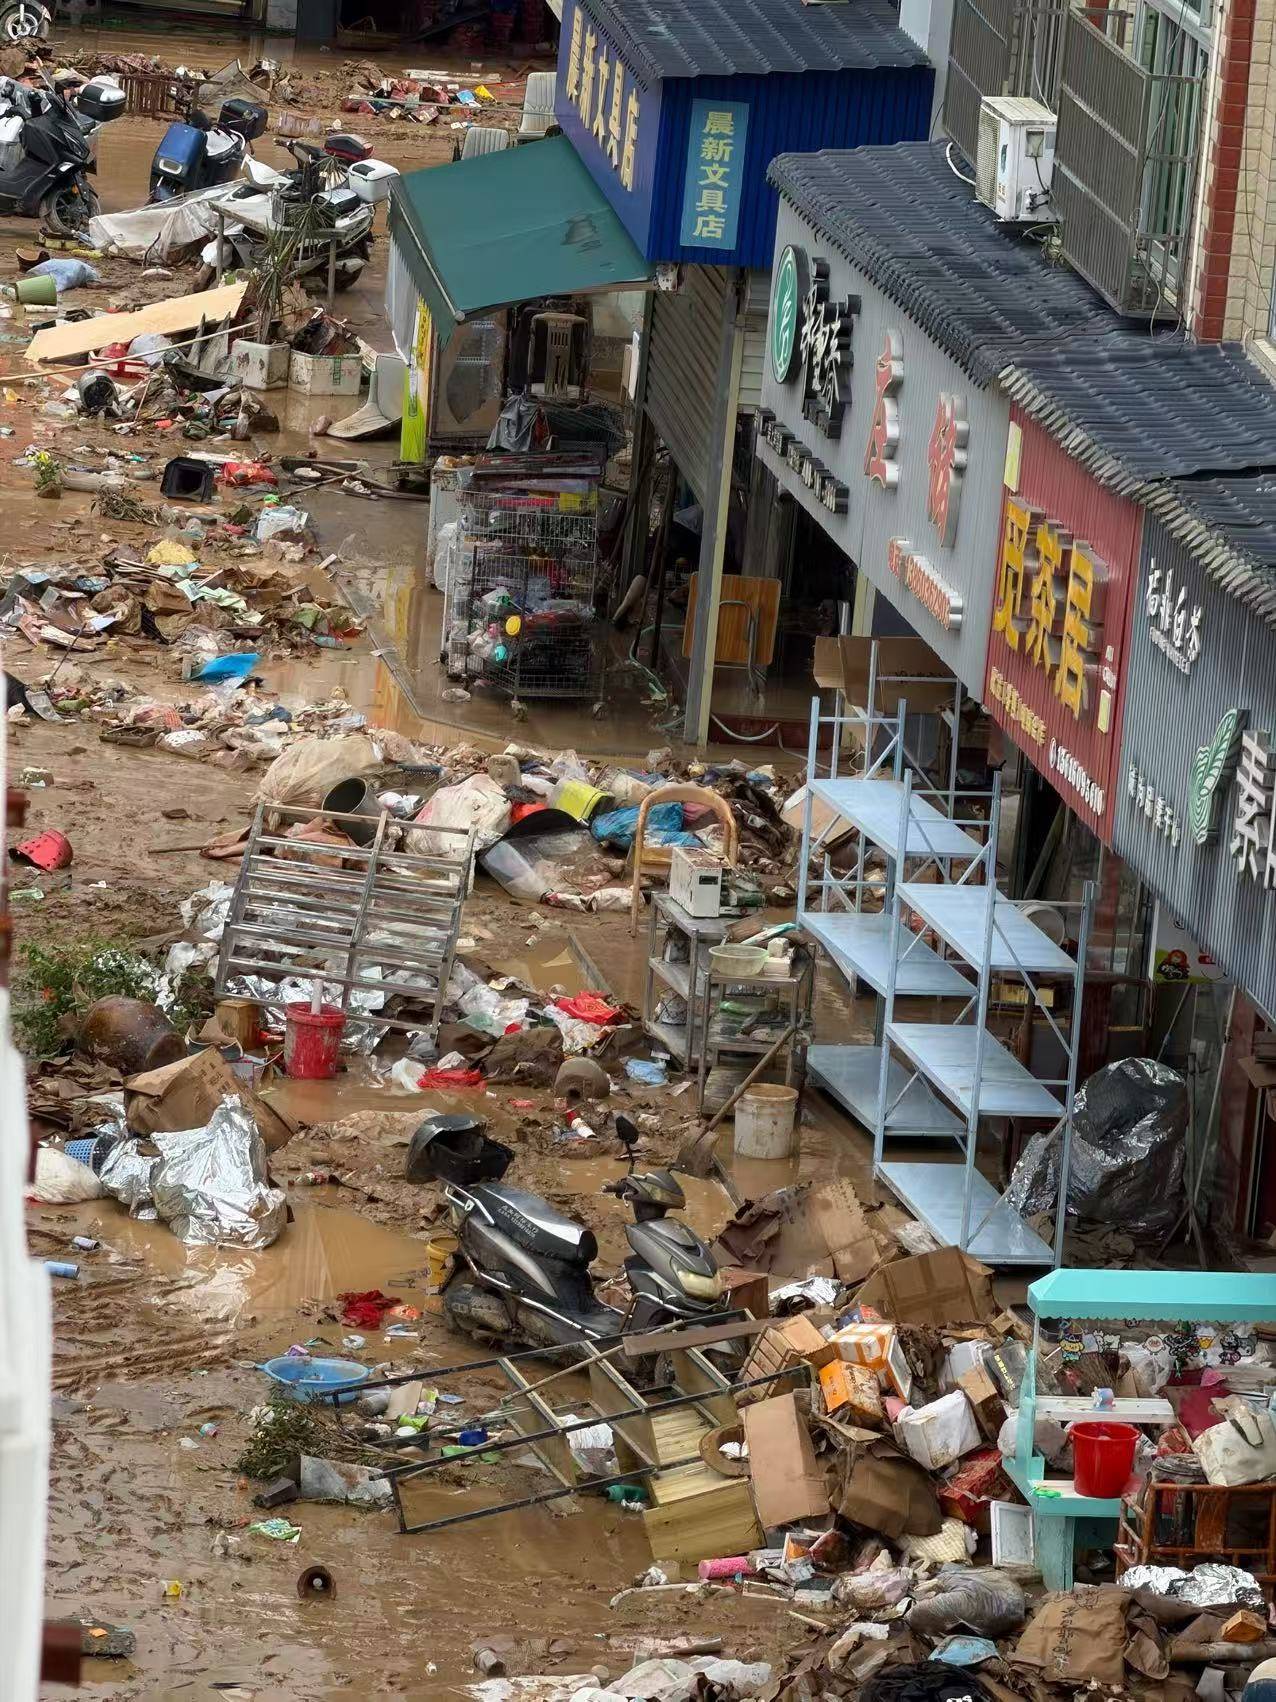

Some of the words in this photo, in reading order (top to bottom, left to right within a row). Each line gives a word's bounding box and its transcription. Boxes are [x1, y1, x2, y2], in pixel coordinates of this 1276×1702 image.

[566, 6, 639, 191] 晨新文具店
[693, 111, 734, 239] 晨新文具店
